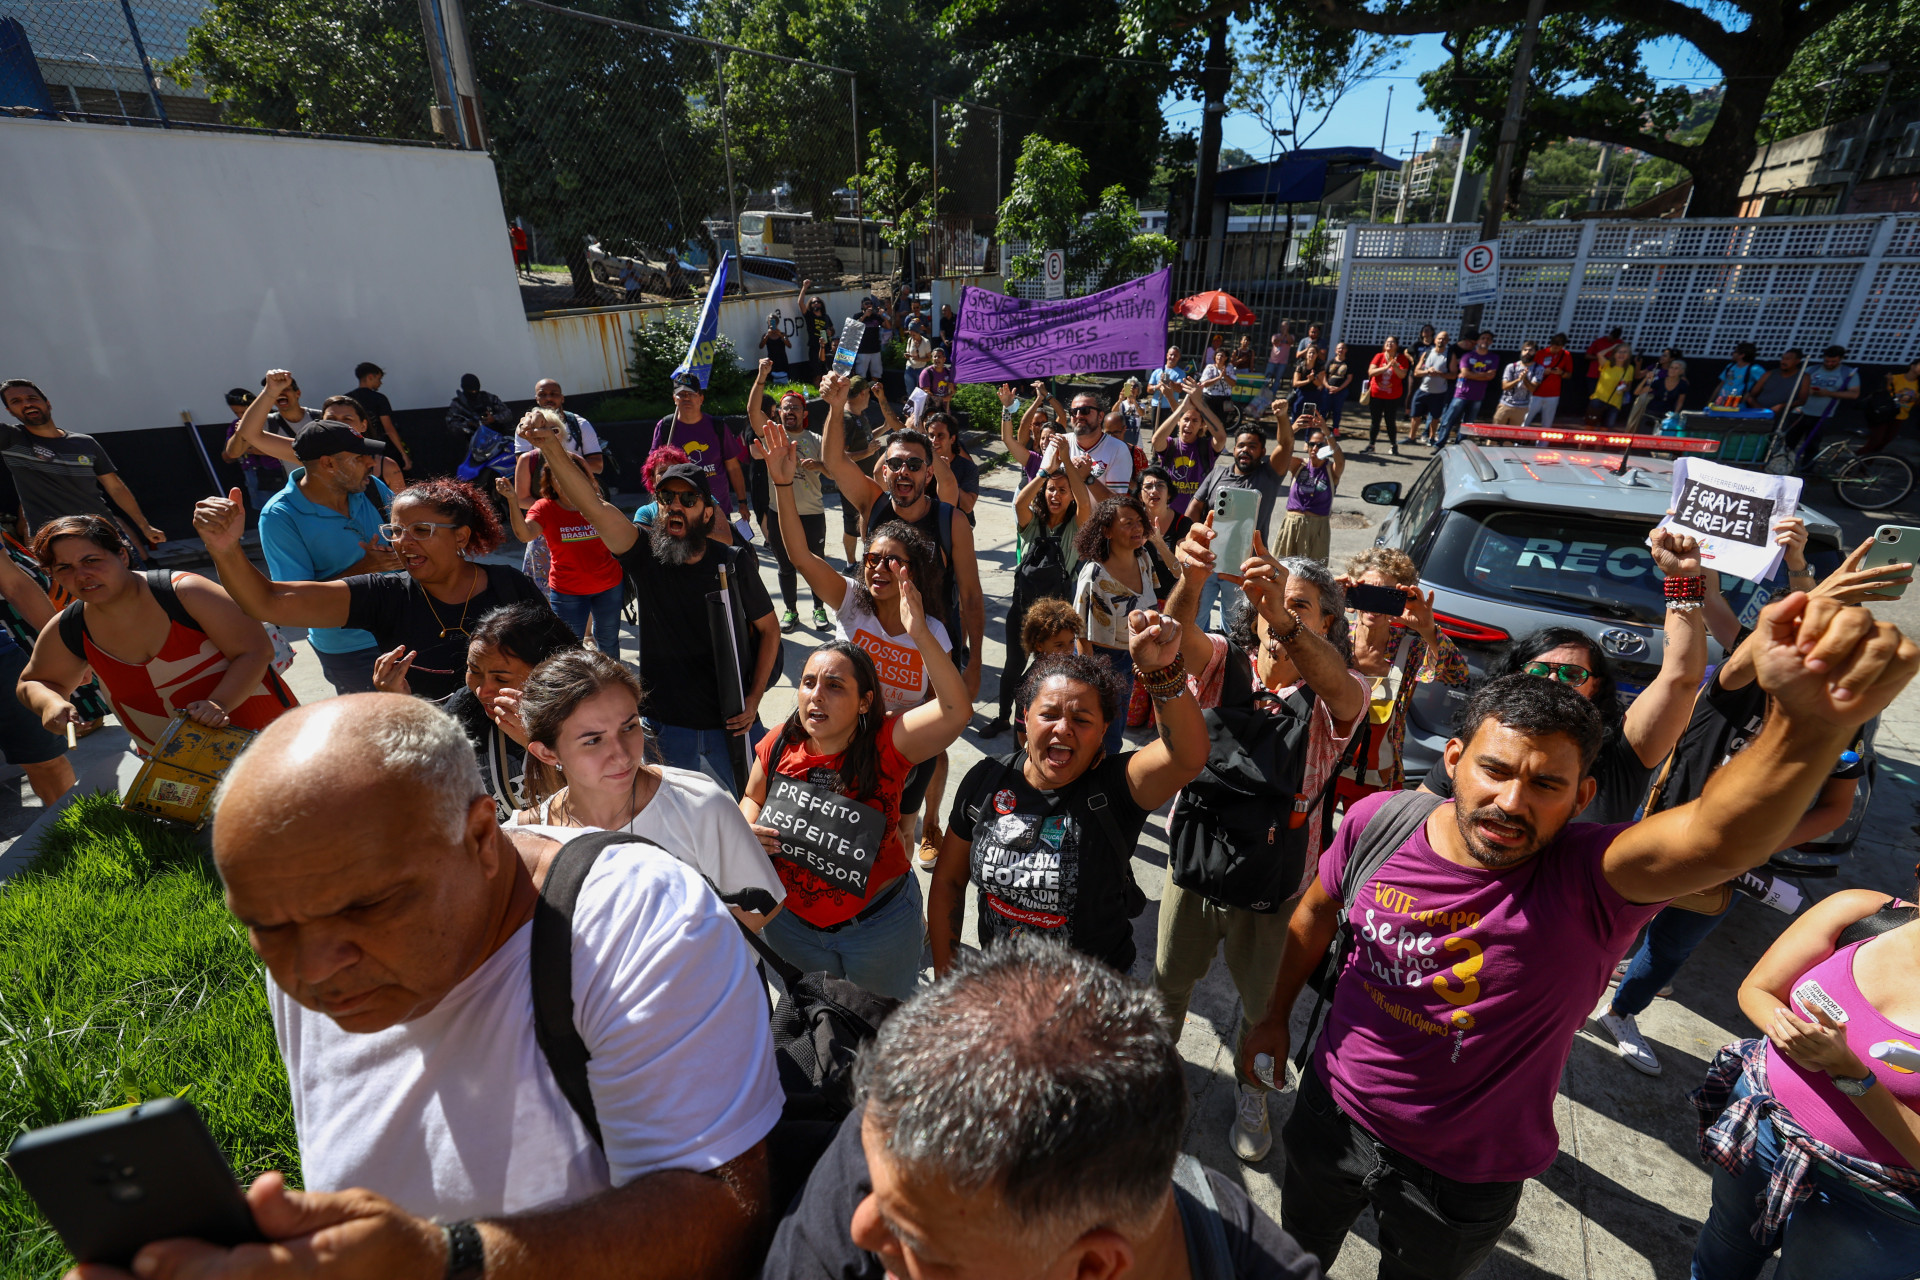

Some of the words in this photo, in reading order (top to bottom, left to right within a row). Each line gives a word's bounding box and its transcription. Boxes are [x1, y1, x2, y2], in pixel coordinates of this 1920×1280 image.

[1052, 259, 1057, 274] E
[1473, 251, 1484, 268] E
[968, 289, 1012, 311] GREVE
[979, 331, 1049, 350] EDUARDO
[1054, 326, 1099, 345] PAES
[1069, 351, 1140, 371] COMBATE
[1687, 481, 1700, 502] É
[1699, 489, 1754, 521] GRAVE,
[1681, 501, 1694, 521] É
[1693, 510, 1753, 539] GREVE!
[856, 635, 912, 666] nossa
[875, 661, 920, 687] ASSE
[776, 781, 861, 824] PREFEITO
[760, 805, 851, 856] RESPEITE
[853, 848, 866, 861] O
[781, 843, 868, 890] OFESSOR!
[984, 846, 1061, 870] SINDICATO
[982, 863, 1060, 890] FORTE
[1018, 895, 1058, 911] MUNDO
[1030, 889, 1059, 904] COM
[1375, 881, 1419, 915] VOTE
[1361, 909, 1436, 960] Sepe
[1432, 937, 1484, 1006] 3
[1367, 946, 1423, 987] luta
[1407, 955, 1439, 972] na
[1811, 983, 1843, 1016] SERVIDOR/A
